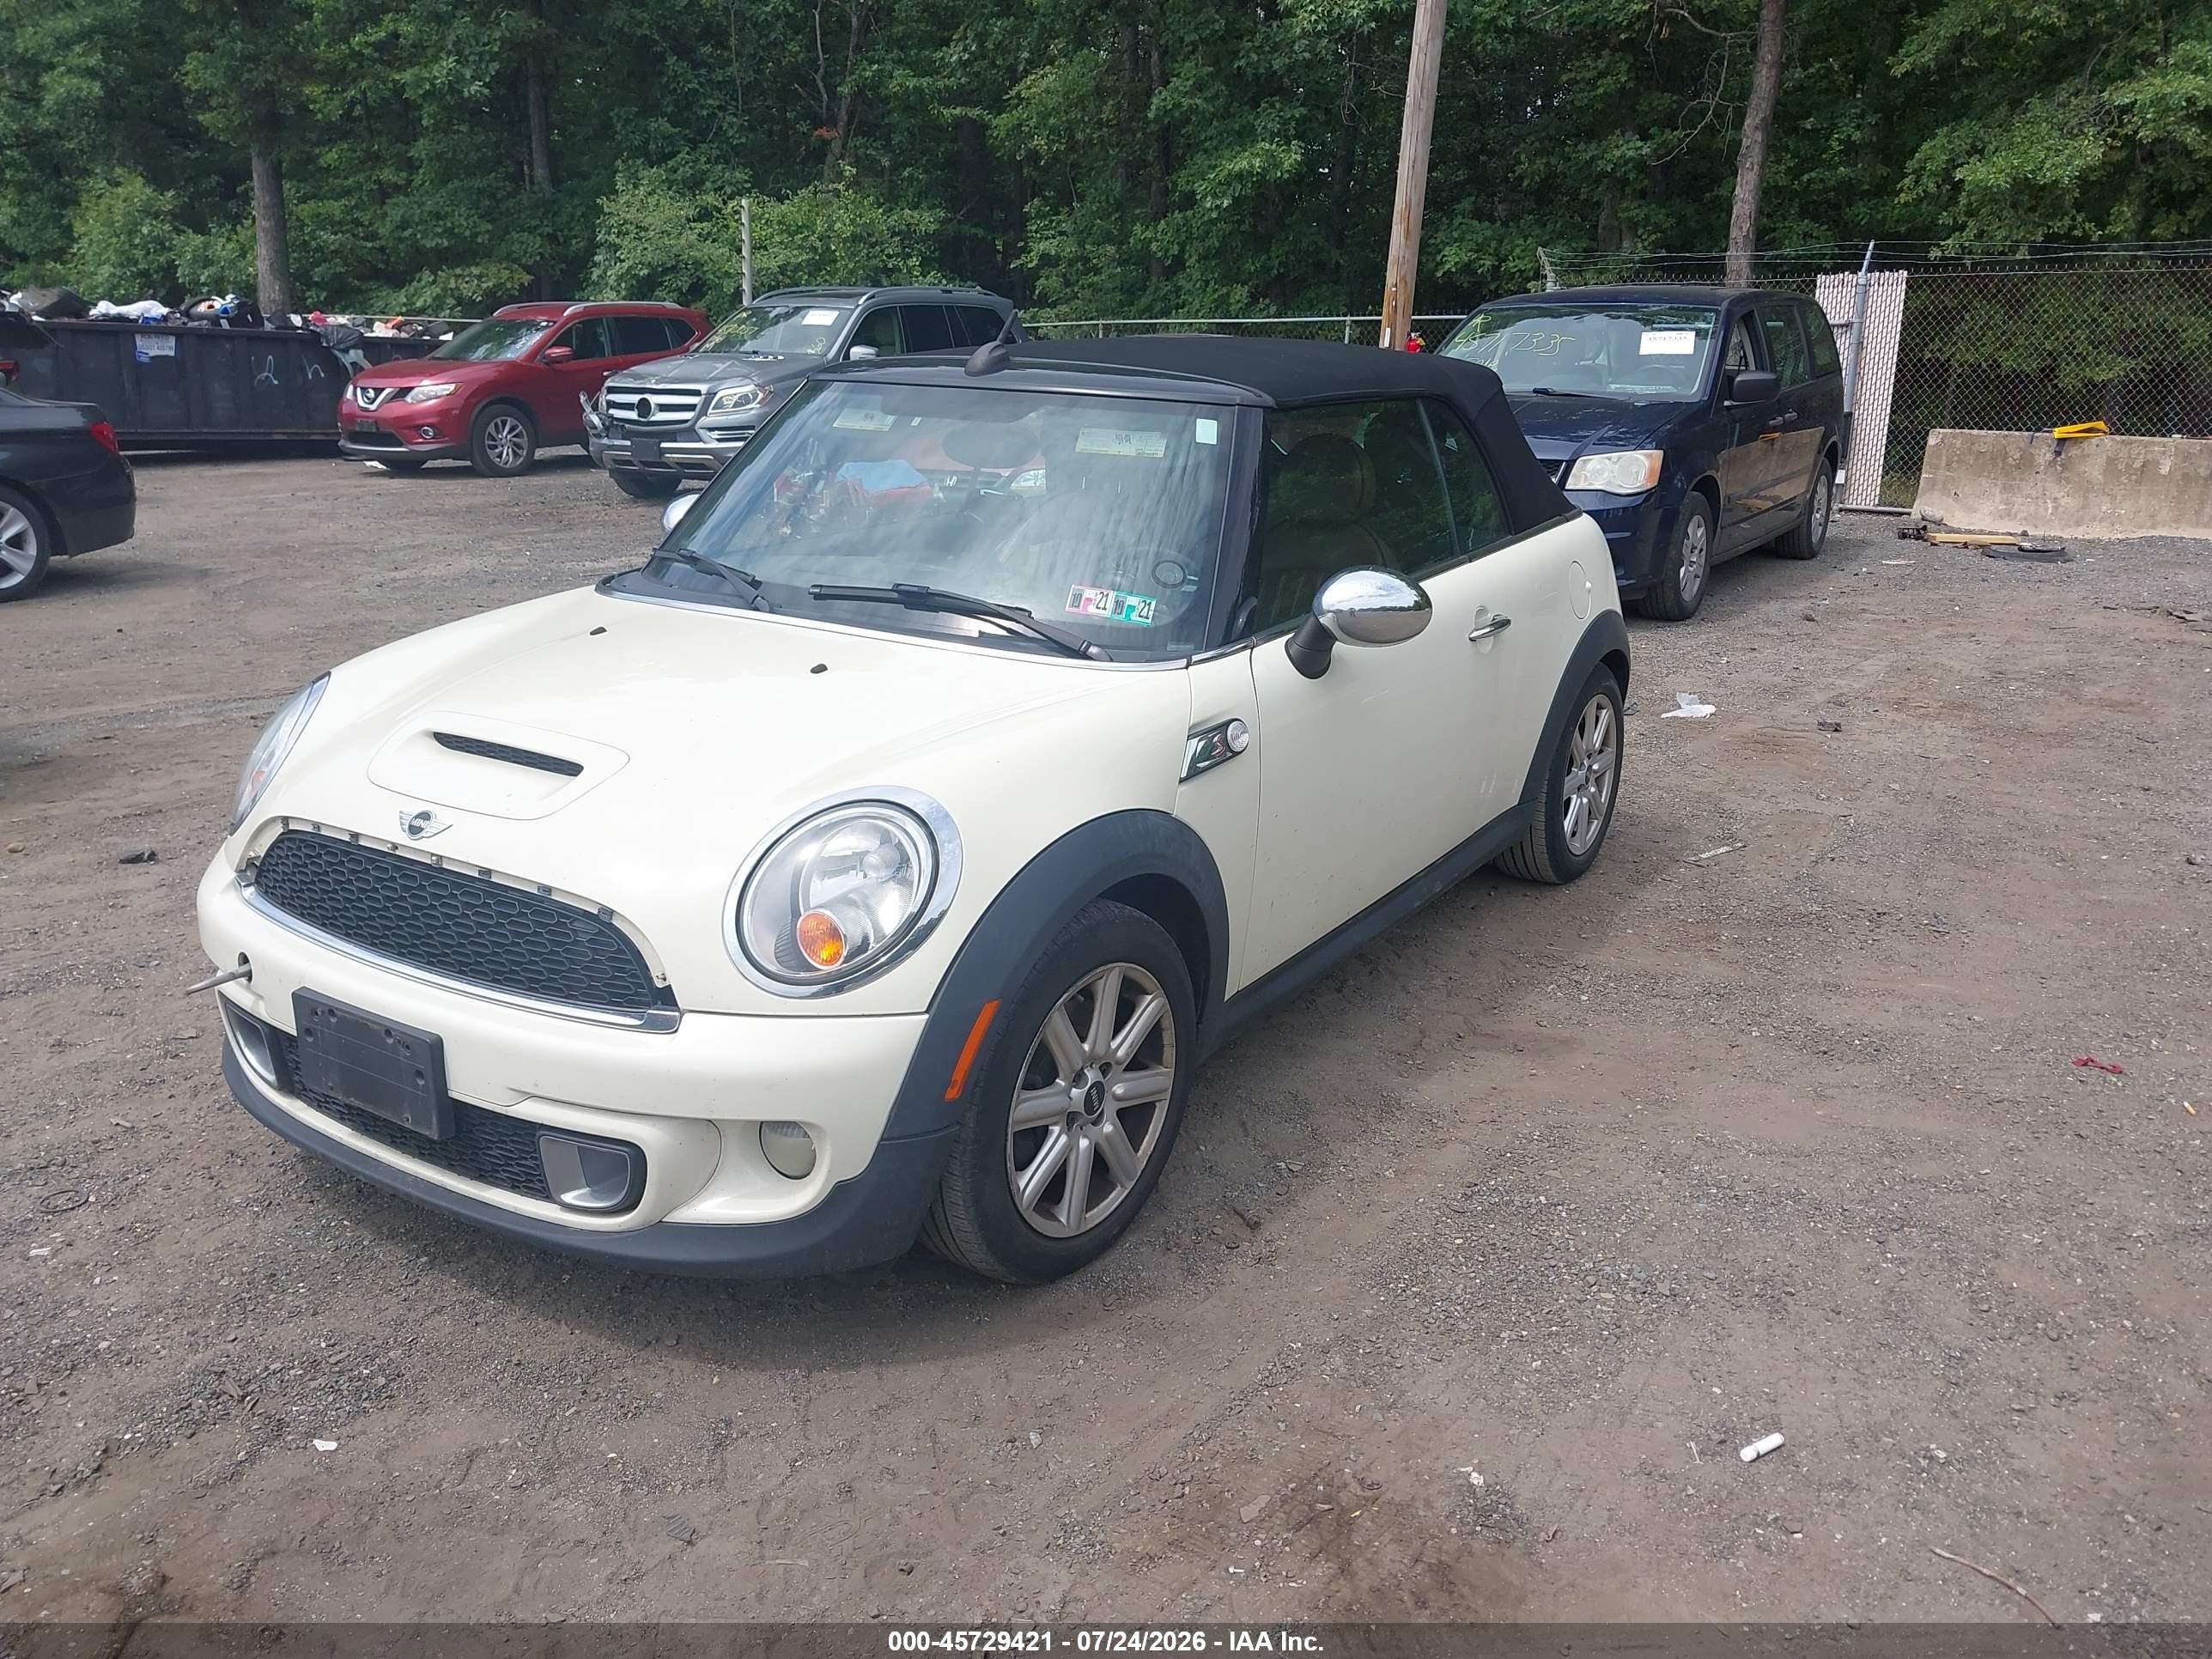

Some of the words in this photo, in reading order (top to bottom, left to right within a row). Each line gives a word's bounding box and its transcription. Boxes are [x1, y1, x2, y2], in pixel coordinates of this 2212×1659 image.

[1096, 591, 1109, 611] 21
[1138, 599, 1152, 620] 21
[410, 817, 431, 830] MINI
[1090, 1086, 1099, 1111] MINI
